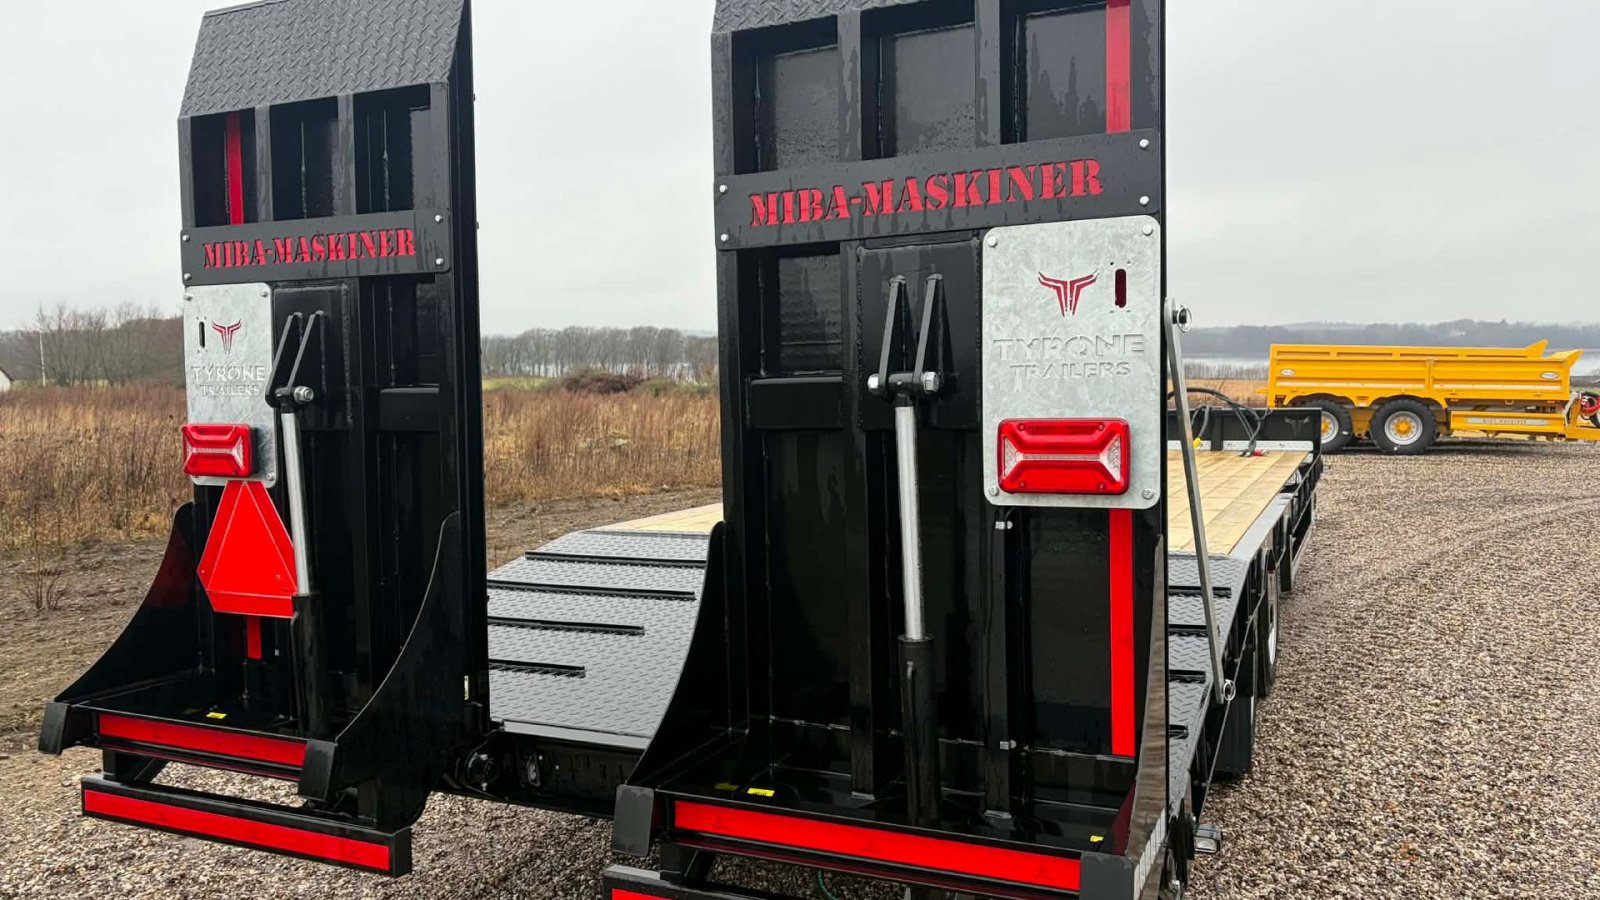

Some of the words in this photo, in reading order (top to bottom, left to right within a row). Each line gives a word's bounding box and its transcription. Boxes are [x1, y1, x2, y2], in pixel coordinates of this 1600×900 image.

[749, 158, 1105, 227] MIBA-MASKINER
[203, 228, 416, 269] MIBA-MASKINER
[993, 334, 1145, 360] TYRONE
[190, 364, 266, 381] TYRONE
[1010, 361, 1131, 378] TRAILERS
[199, 384, 260, 396] TRAILERS
